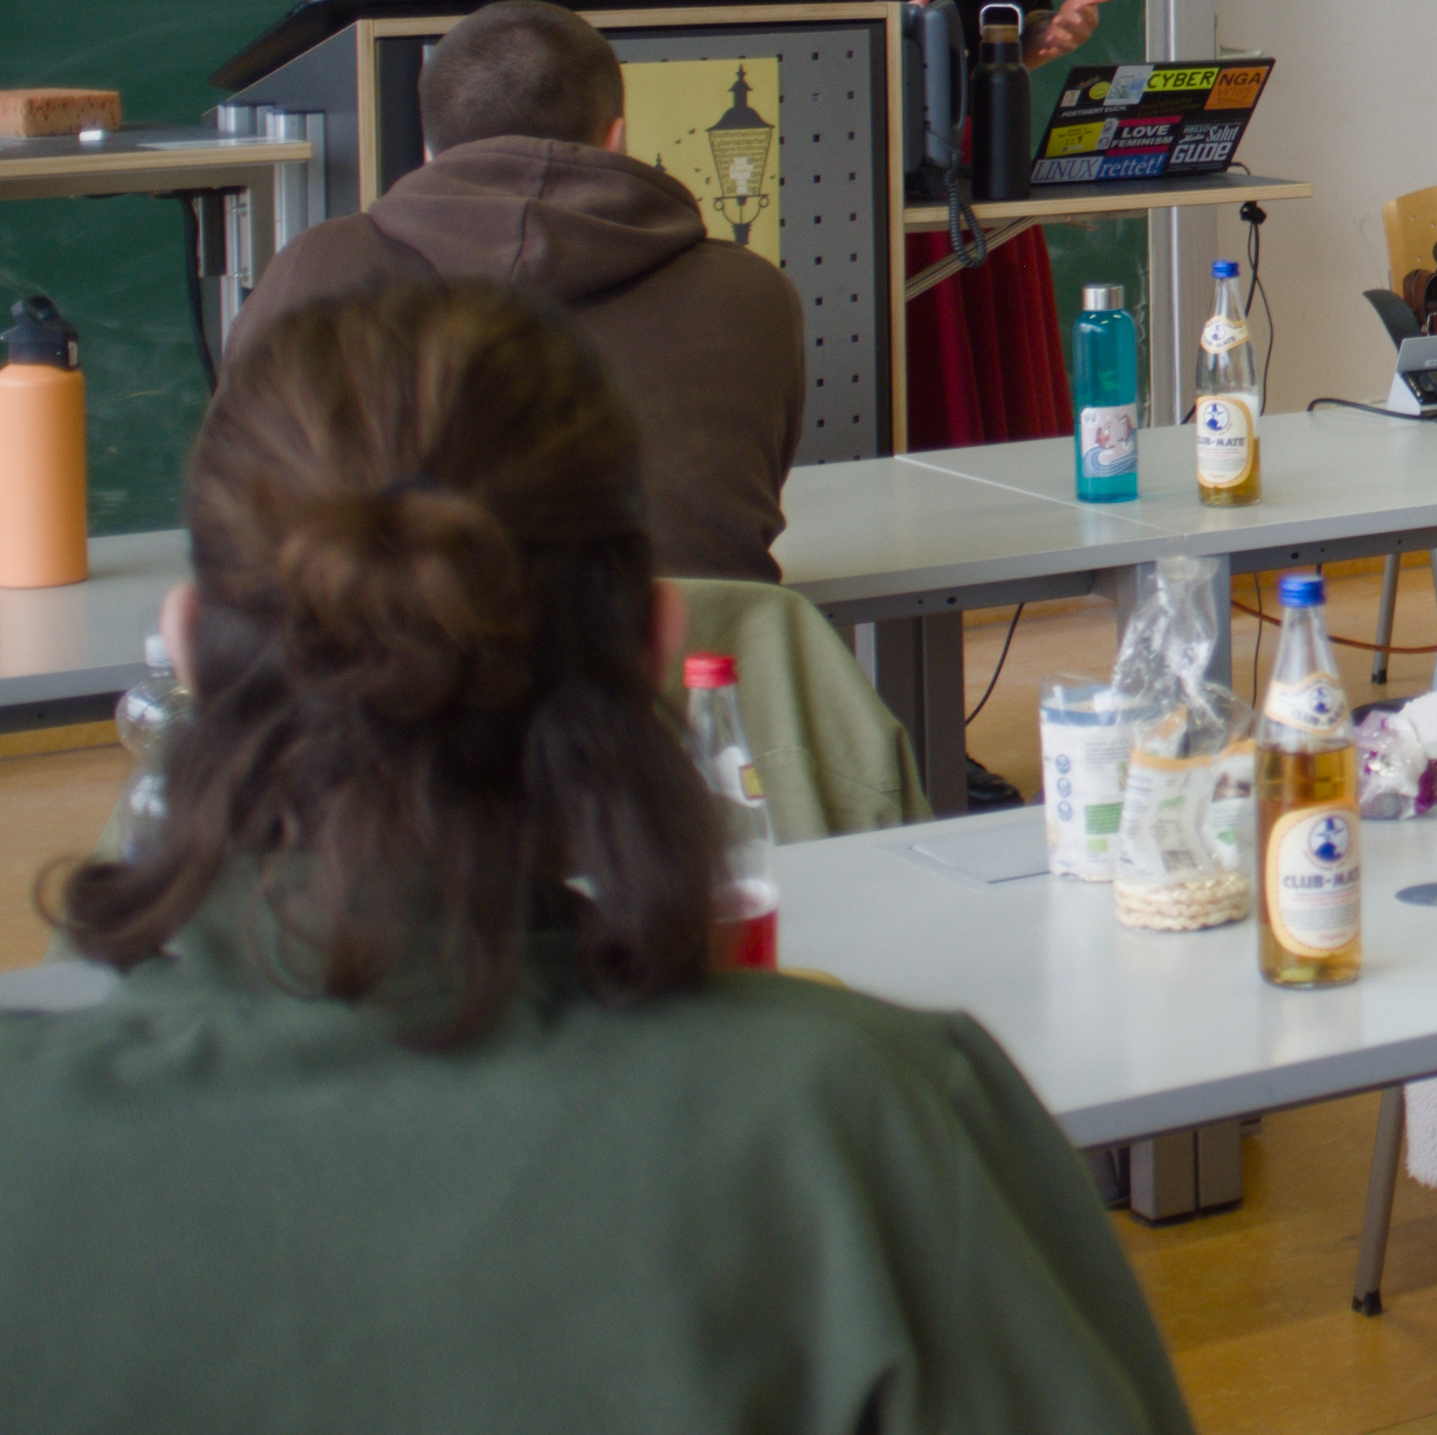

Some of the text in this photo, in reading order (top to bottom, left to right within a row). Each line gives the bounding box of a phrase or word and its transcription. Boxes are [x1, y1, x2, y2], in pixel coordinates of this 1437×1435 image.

[1146, 70, 1214, 89] CYBER
[1218, 72, 1262, 86] NGA
[1121, 125, 1170, 139] LOVE
[1111, 136, 1173, 148] FEMINISM
[1032, 159, 1099, 182] LINUX
